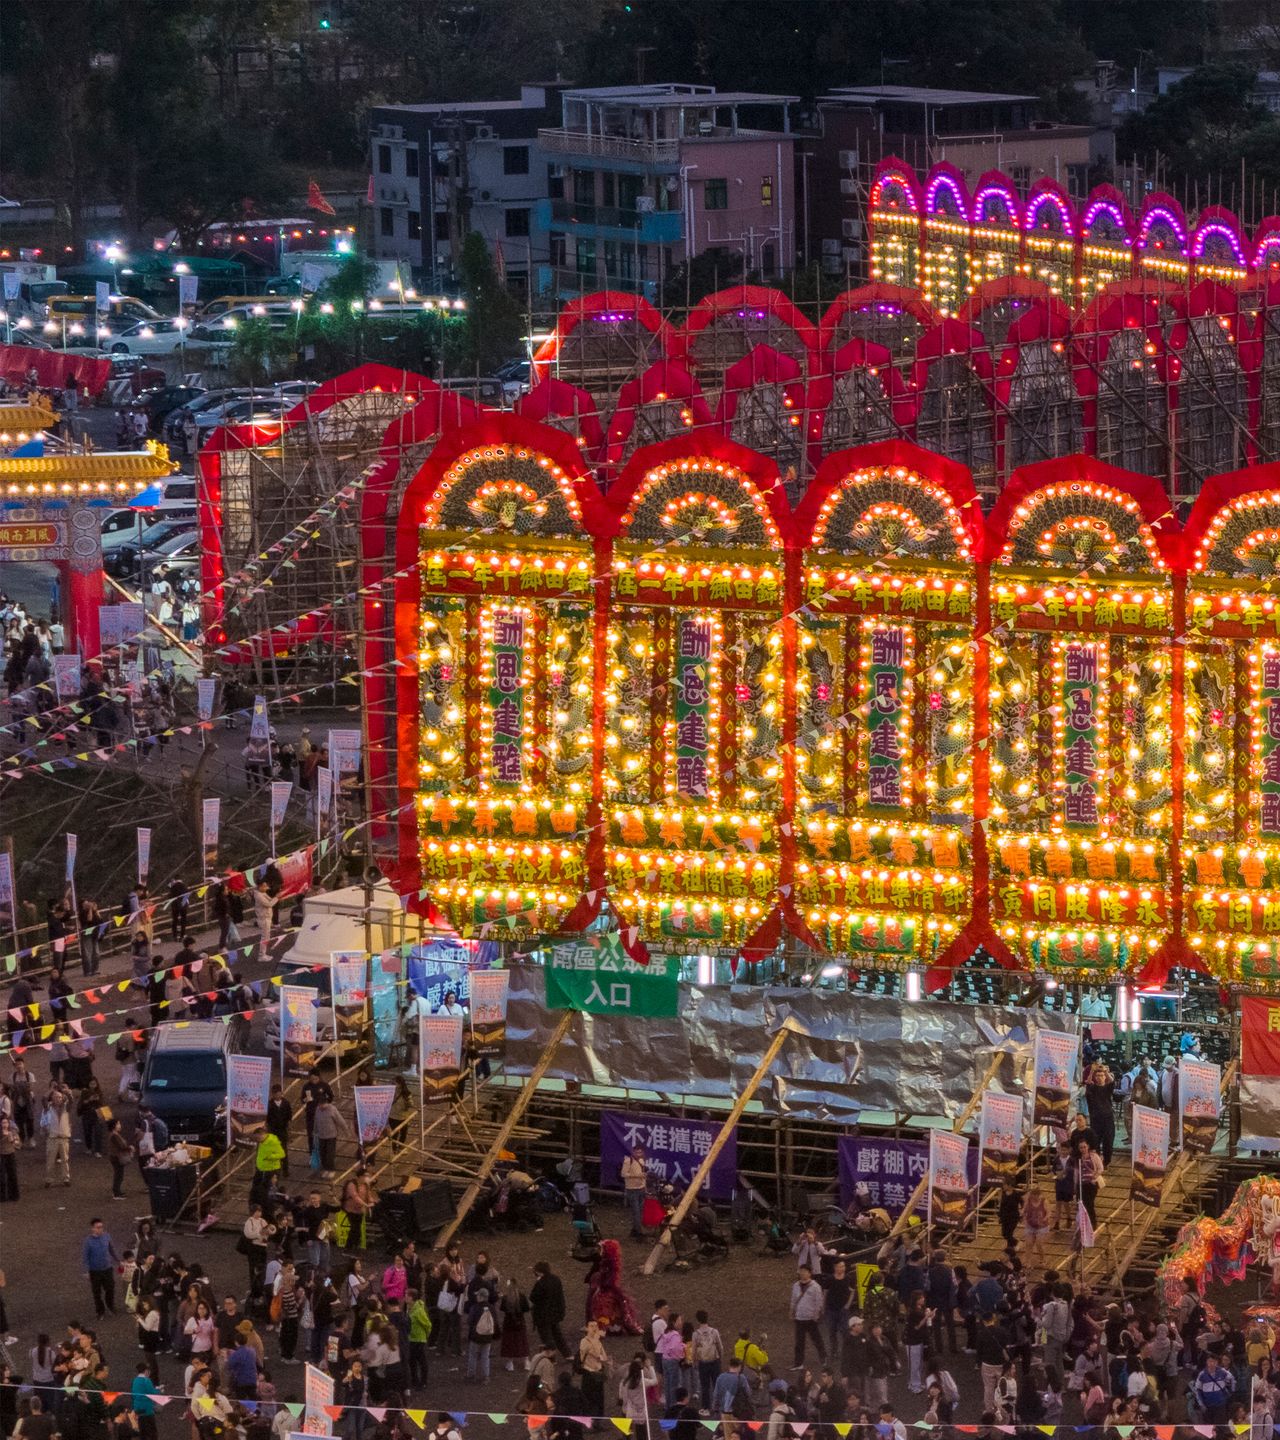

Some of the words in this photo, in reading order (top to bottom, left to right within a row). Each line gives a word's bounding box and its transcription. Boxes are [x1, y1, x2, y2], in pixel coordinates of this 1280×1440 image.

[492, 610, 523, 782] 酬恩建醮
[677, 622, 710, 796] 酬恩建醮
[869, 629, 903, 806] 酬恩建醮
[1065, 645, 1098, 823] 酬恩建醮
[584, 982, 631, 1007] 入口
[623, 1122, 713, 1156] 不准攜帶
